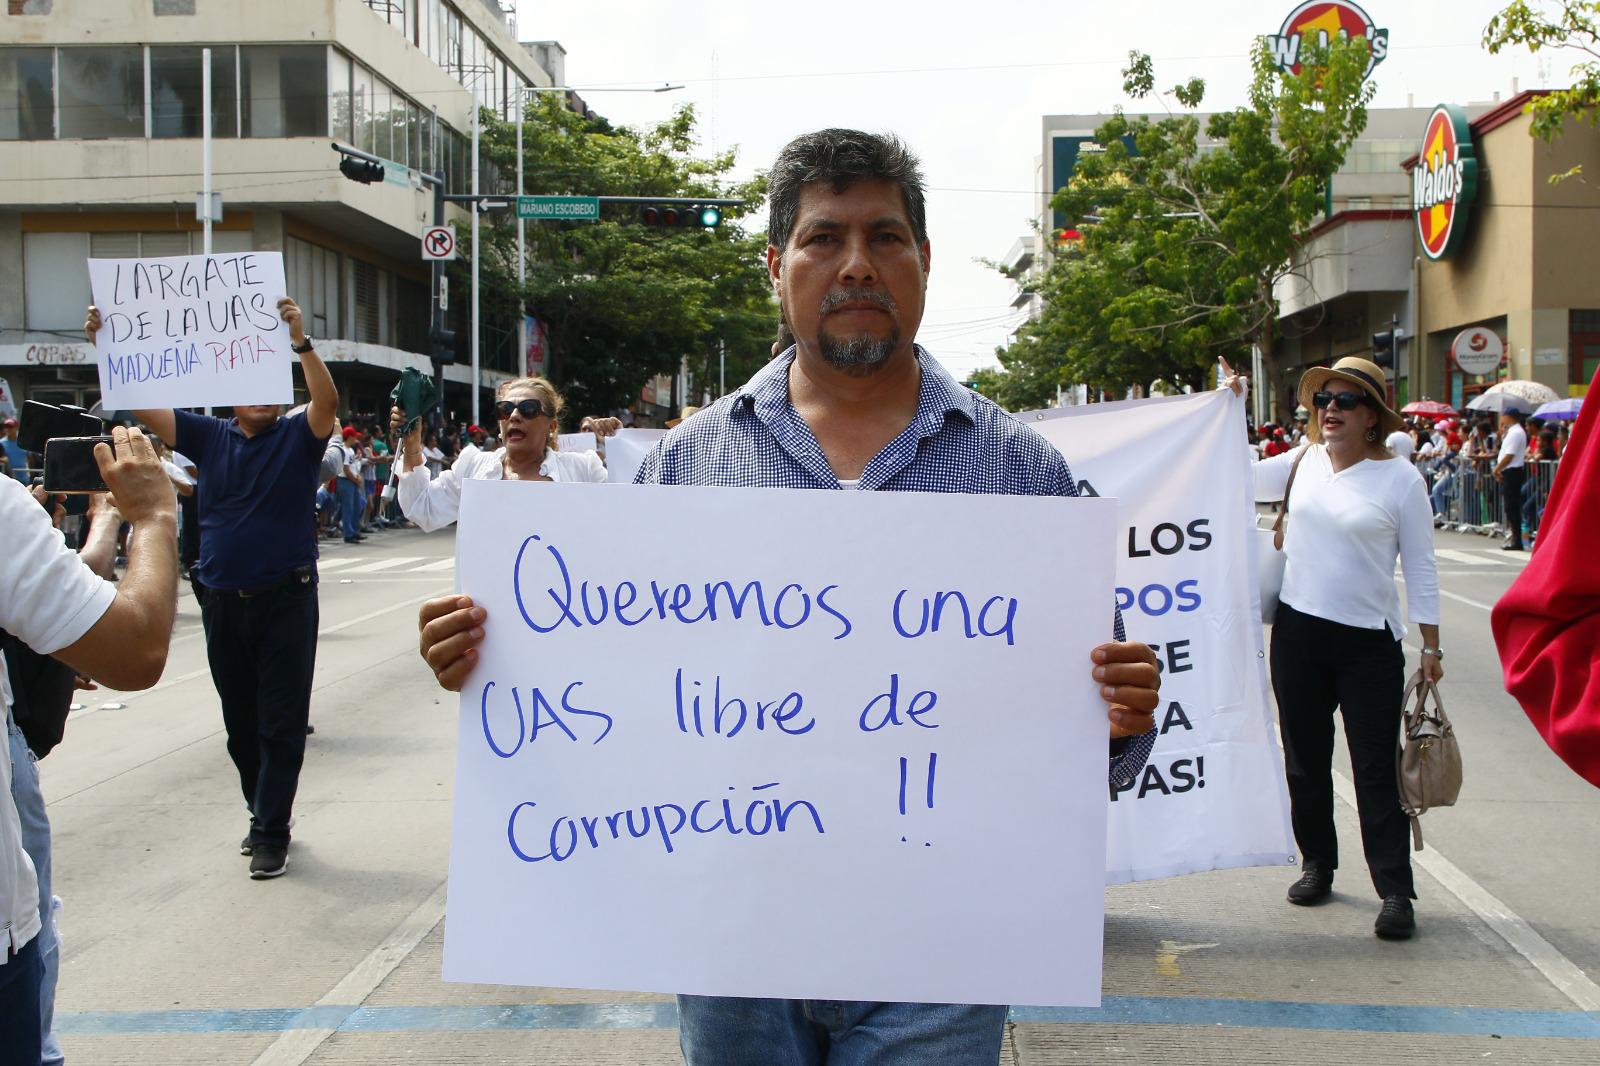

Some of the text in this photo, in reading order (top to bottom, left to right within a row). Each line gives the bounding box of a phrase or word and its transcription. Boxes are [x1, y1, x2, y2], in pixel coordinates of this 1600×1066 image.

[1267, 26, 1387, 66] Wl's
[1414, 145, 1463, 210] Waldo's
[520, 204, 595, 214] MARIANO ESCOBEDO
[114, 255, 264, 305] LARGATE
[105, 312, 152, 343] DE
[108, 334, 276, 390] MADUEÑA RATA
[1128, 519, 1212, 558] LOS
[514, 535, 1018, 646] Queremos una
[481, 668, 940, 758] UAS libre de
[1160, 701, 1193, 735] A
